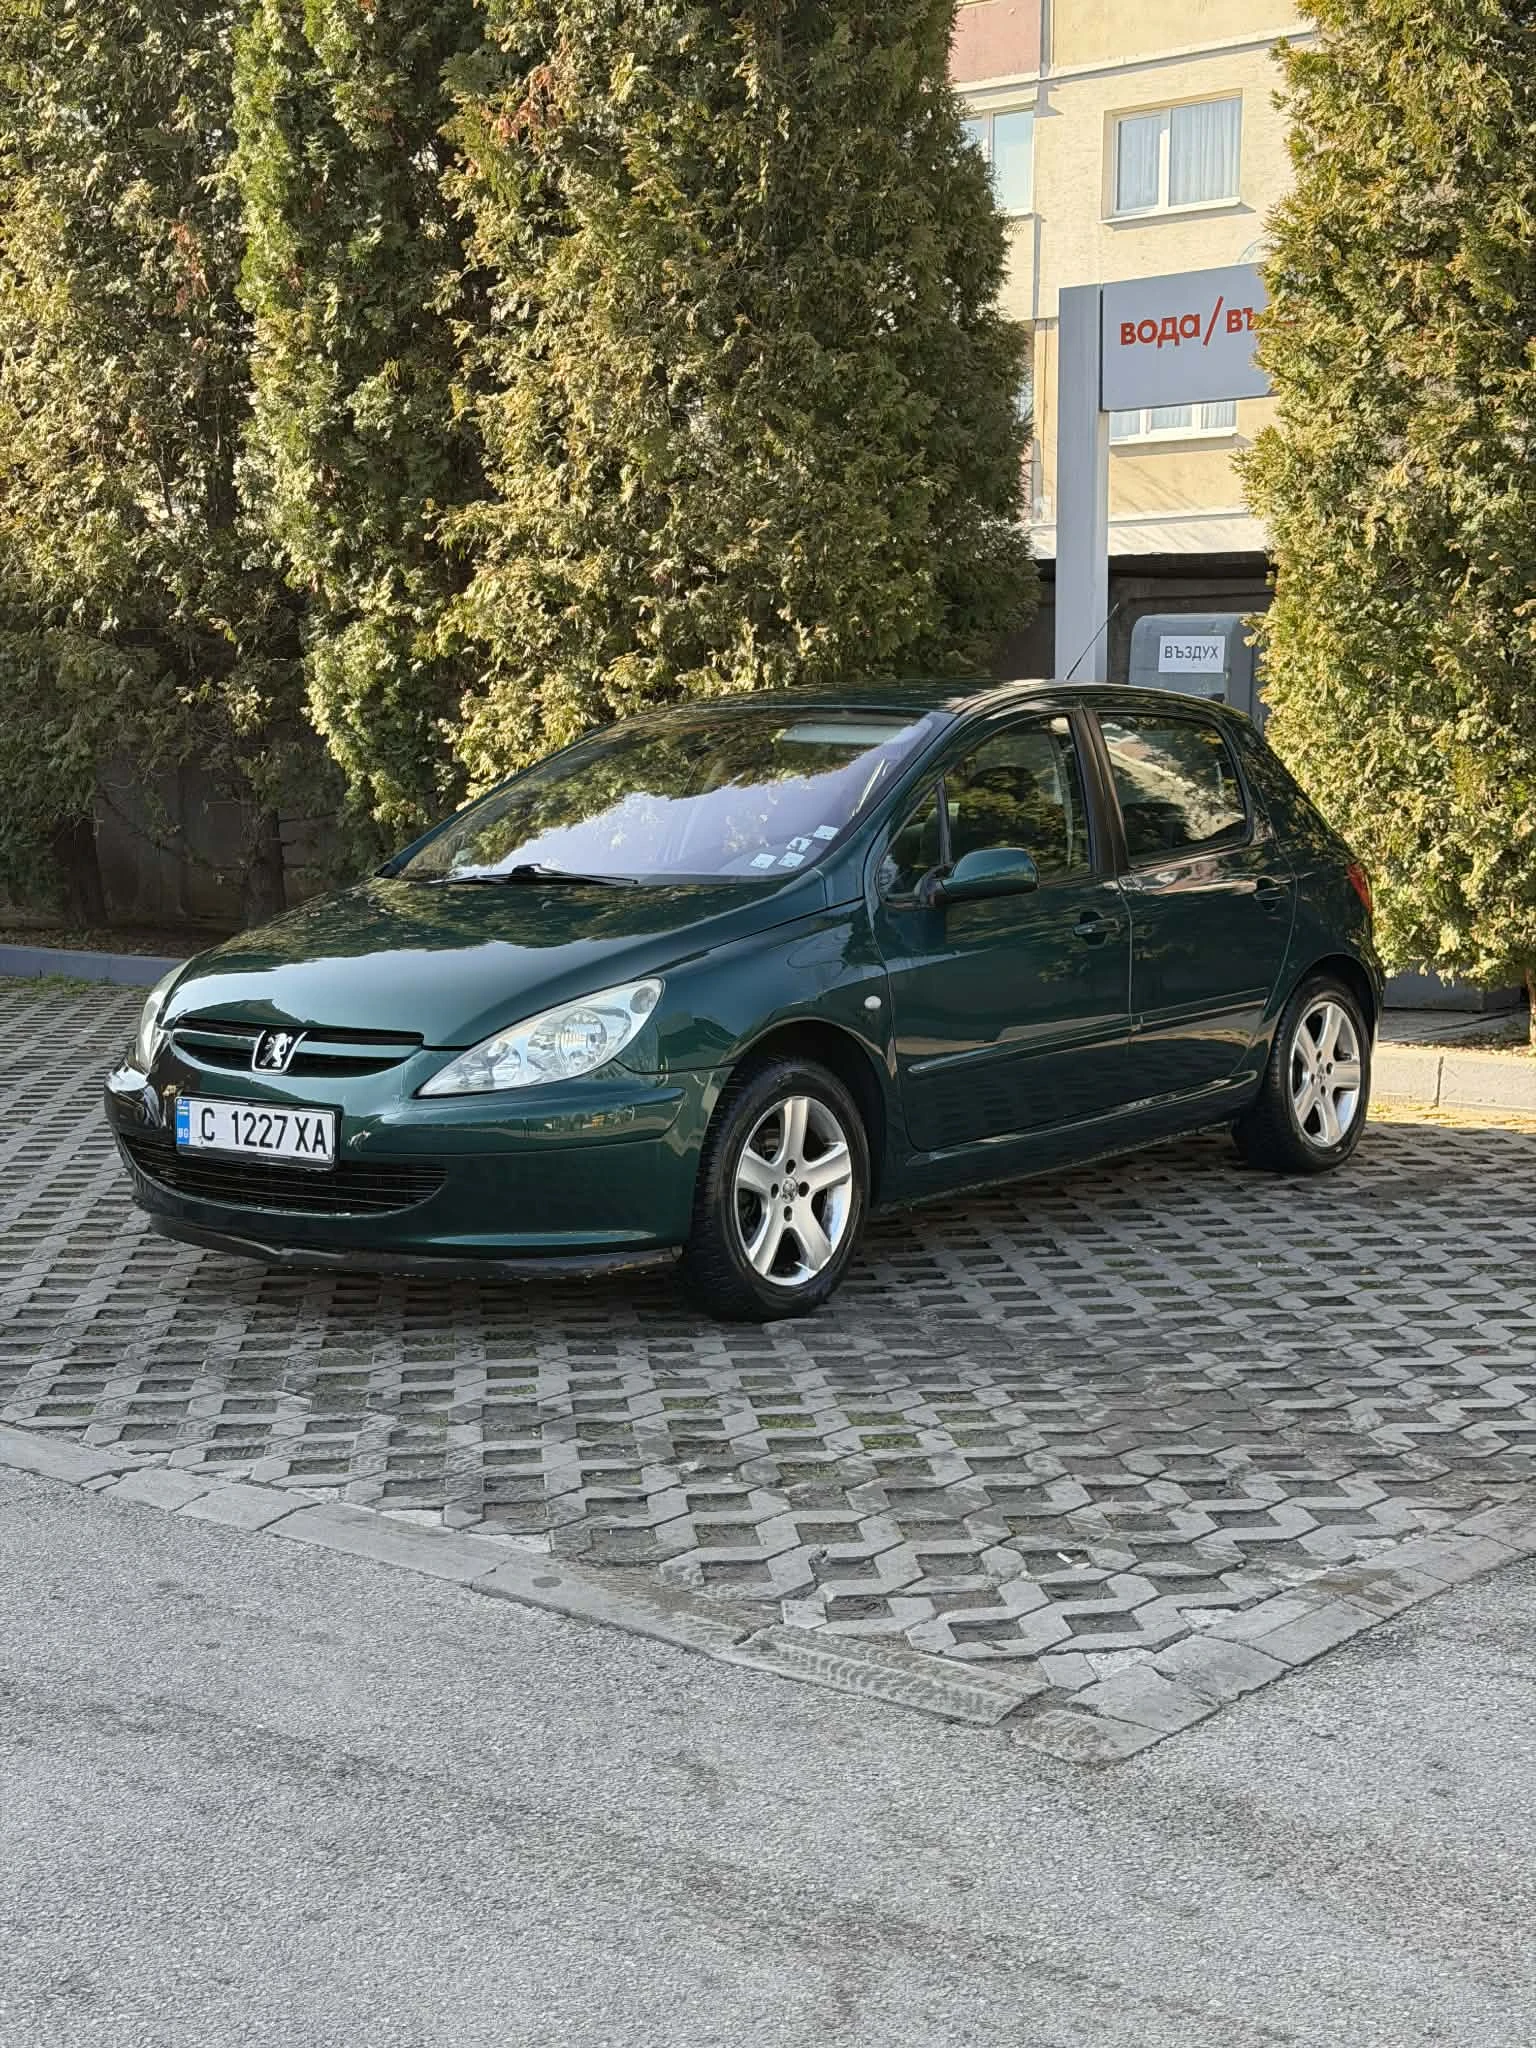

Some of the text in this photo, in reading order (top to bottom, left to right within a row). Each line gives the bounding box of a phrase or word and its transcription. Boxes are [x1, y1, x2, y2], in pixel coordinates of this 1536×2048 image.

[1120, 295, 1256, 349] вода/въ
[1164, 645, 1219, 662] ВЪЗДУХ
[201, 1107, 327, 1154] C 1227 XA
